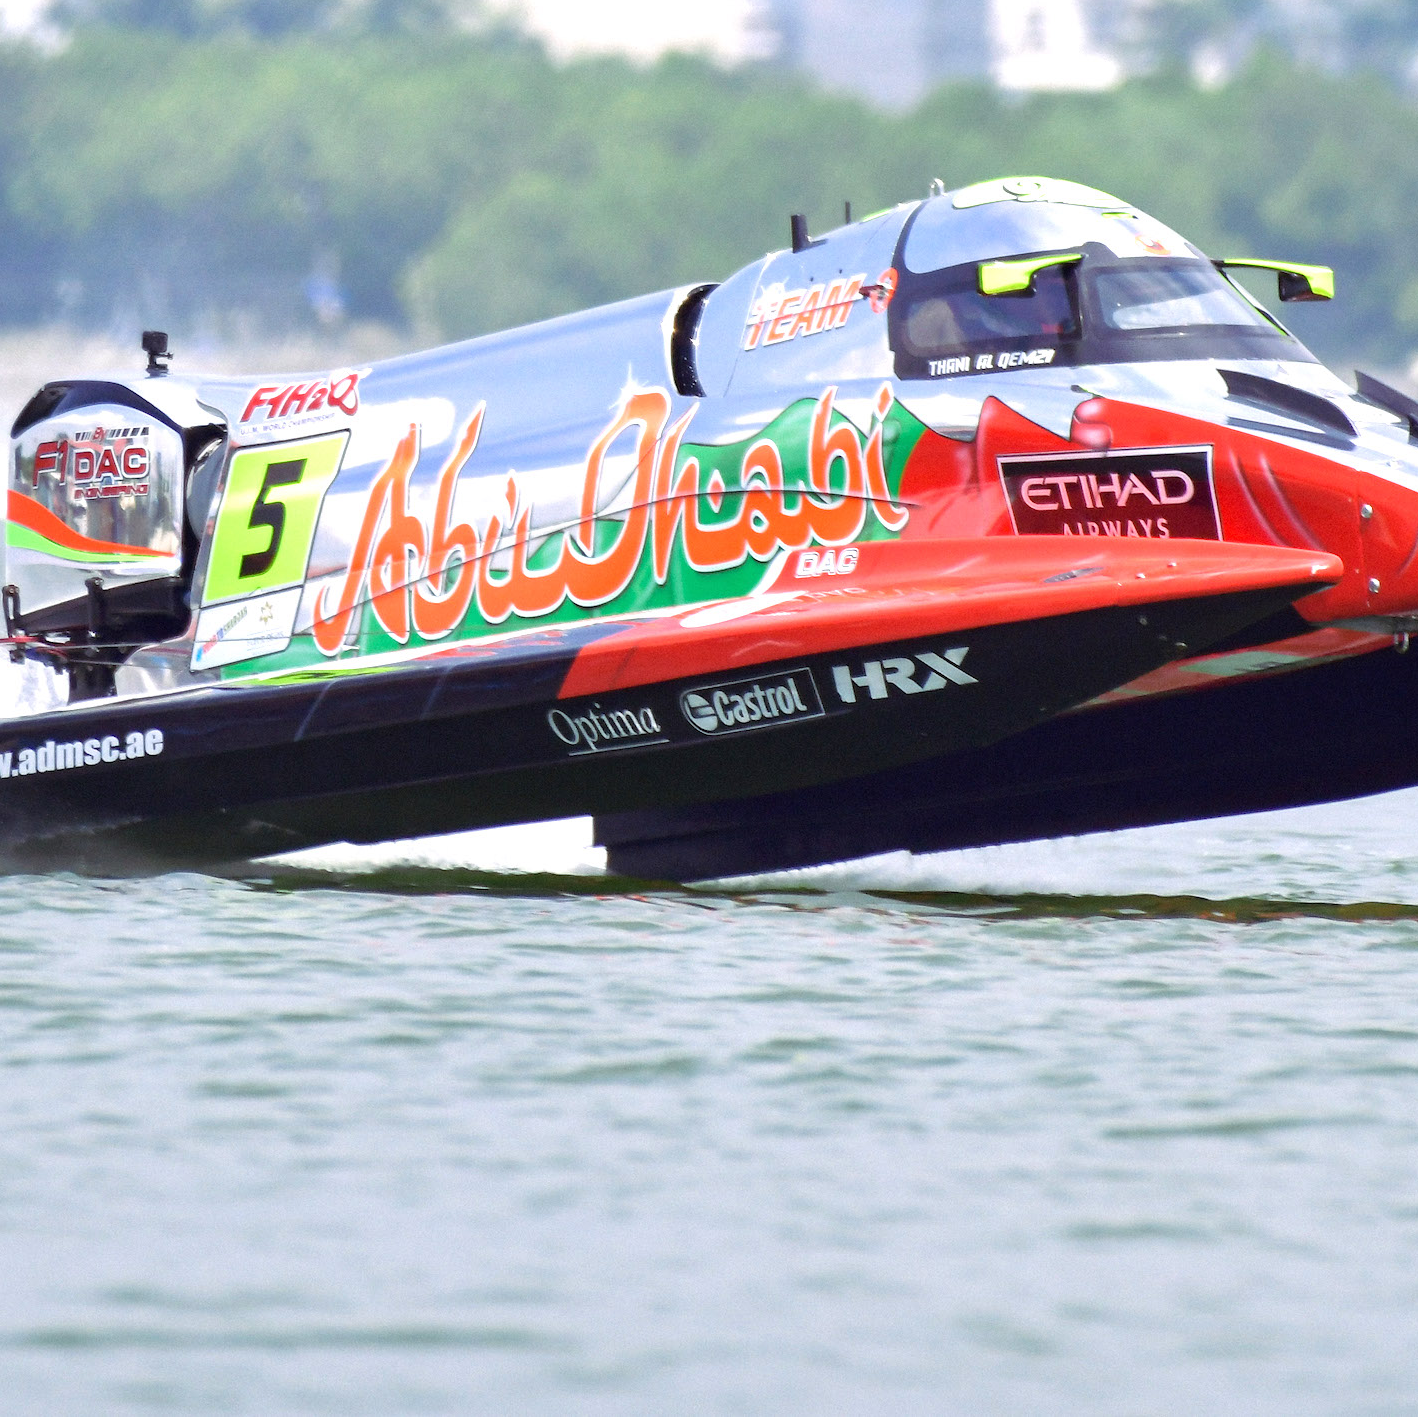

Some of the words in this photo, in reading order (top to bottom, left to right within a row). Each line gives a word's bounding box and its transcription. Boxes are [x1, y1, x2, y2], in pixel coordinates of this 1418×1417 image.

[744, 273, 867, 351] TEAM
[929, 356, 970, 376] THANI
[976, 354, 993, 370] AL
[33, 439, 69, 490] F1
[73, 445, 151, 485] DAC
[1021, 469, 1195, 511] ETIHAD
[239, 458, 308, 580] 5
[313, 399, 571, 658] Abu
[561, 380, 909, 608] Dhabi
[795, 547, 860, 579] DAC
[832, 646, 979, 704] HRX
[547, 702, 662, 751] Optima
[715, 678, 807, 727] Castrol
